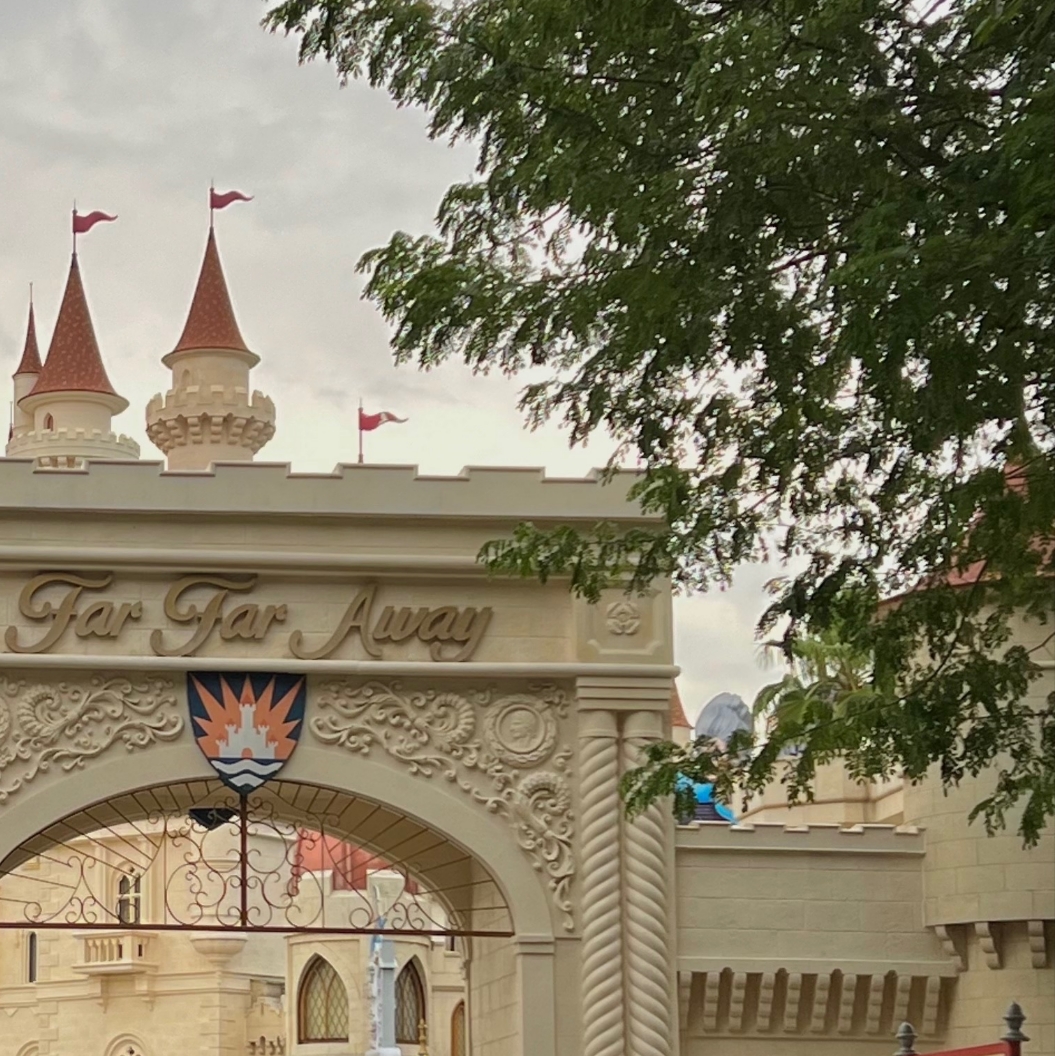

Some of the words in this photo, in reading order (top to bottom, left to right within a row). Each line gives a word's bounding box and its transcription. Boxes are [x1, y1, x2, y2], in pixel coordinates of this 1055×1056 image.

[4, 572, 142, 654] Far
[149, 575, 287, 656] Far
[289, 583, 493, 662] Away
